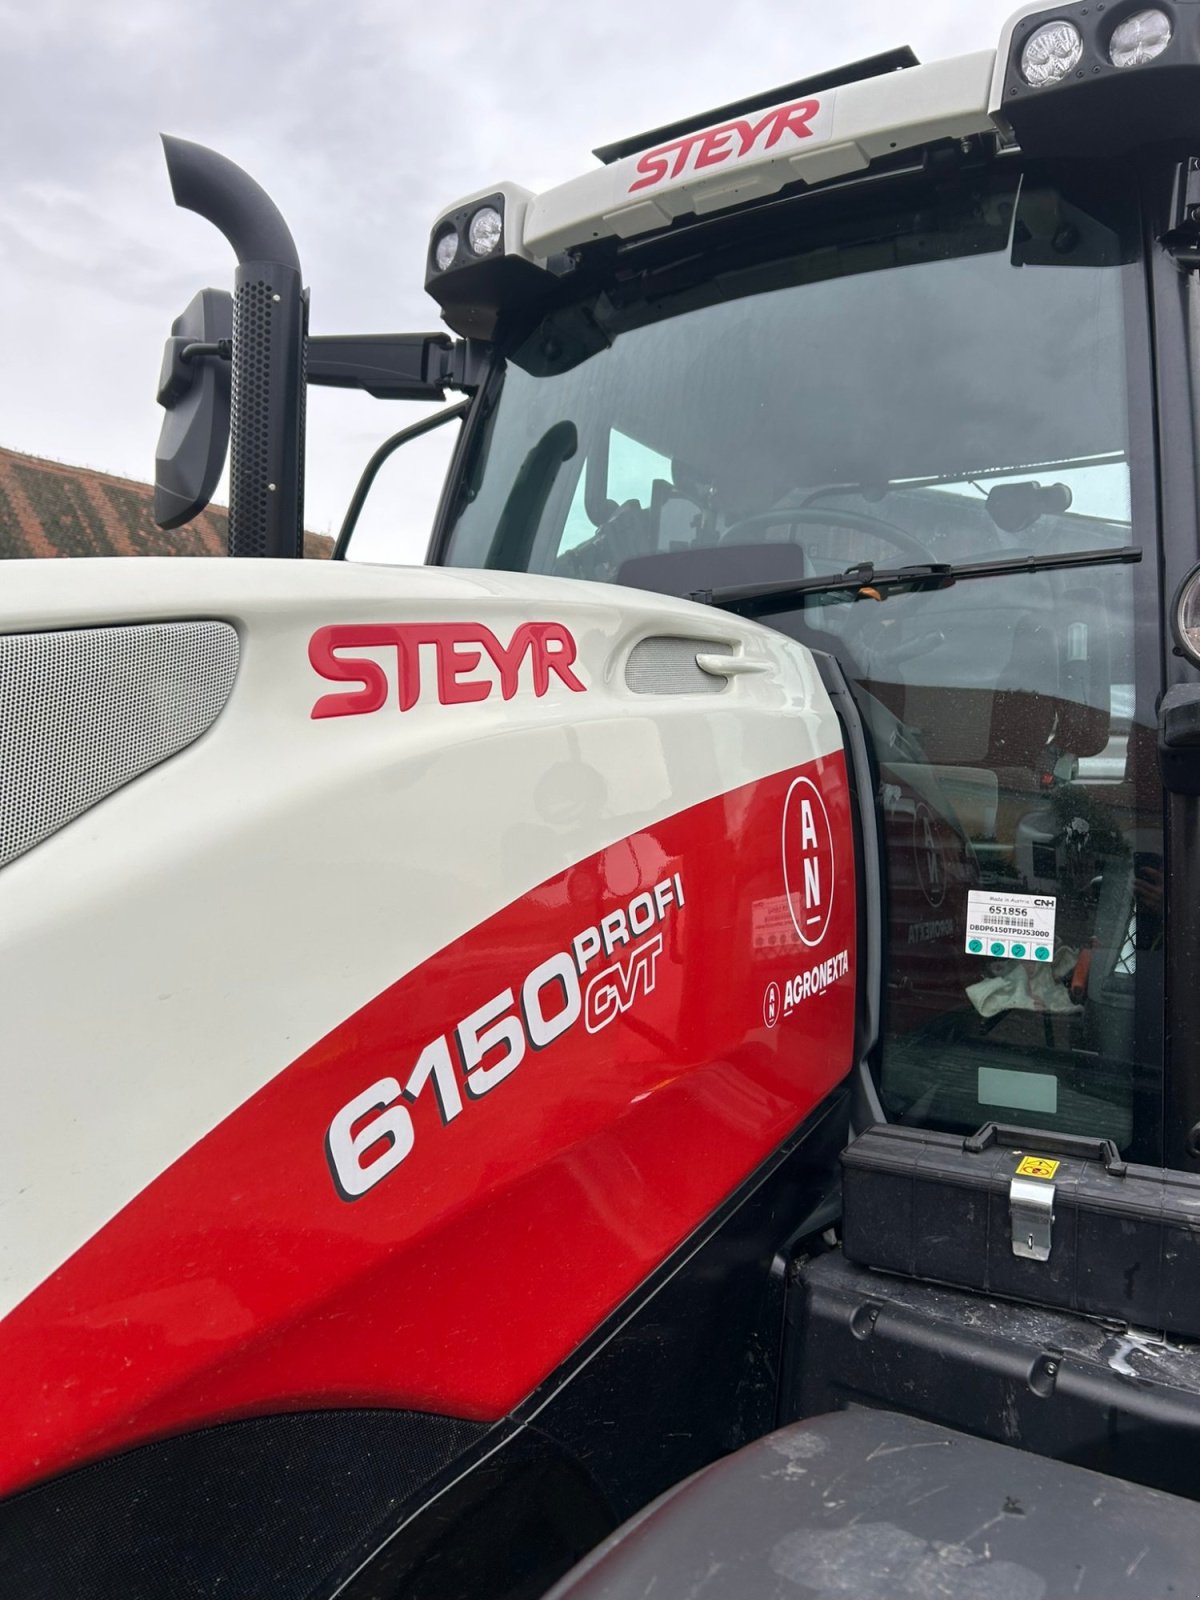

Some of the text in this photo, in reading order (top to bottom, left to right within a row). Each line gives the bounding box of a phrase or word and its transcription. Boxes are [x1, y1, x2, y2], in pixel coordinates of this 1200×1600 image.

[628, 99, 820, 193] STEYR
[308, 622, 587, 719] STEYR
[989, 905, 1028, 917] 651856
[1033, 899, 1055, 907] CNH
[585, 932, 664, 1034] CVT
[783, 949, 849, 1012] AGRONEXTA
[324, 872, 685, 1203] 6150 PROFI
